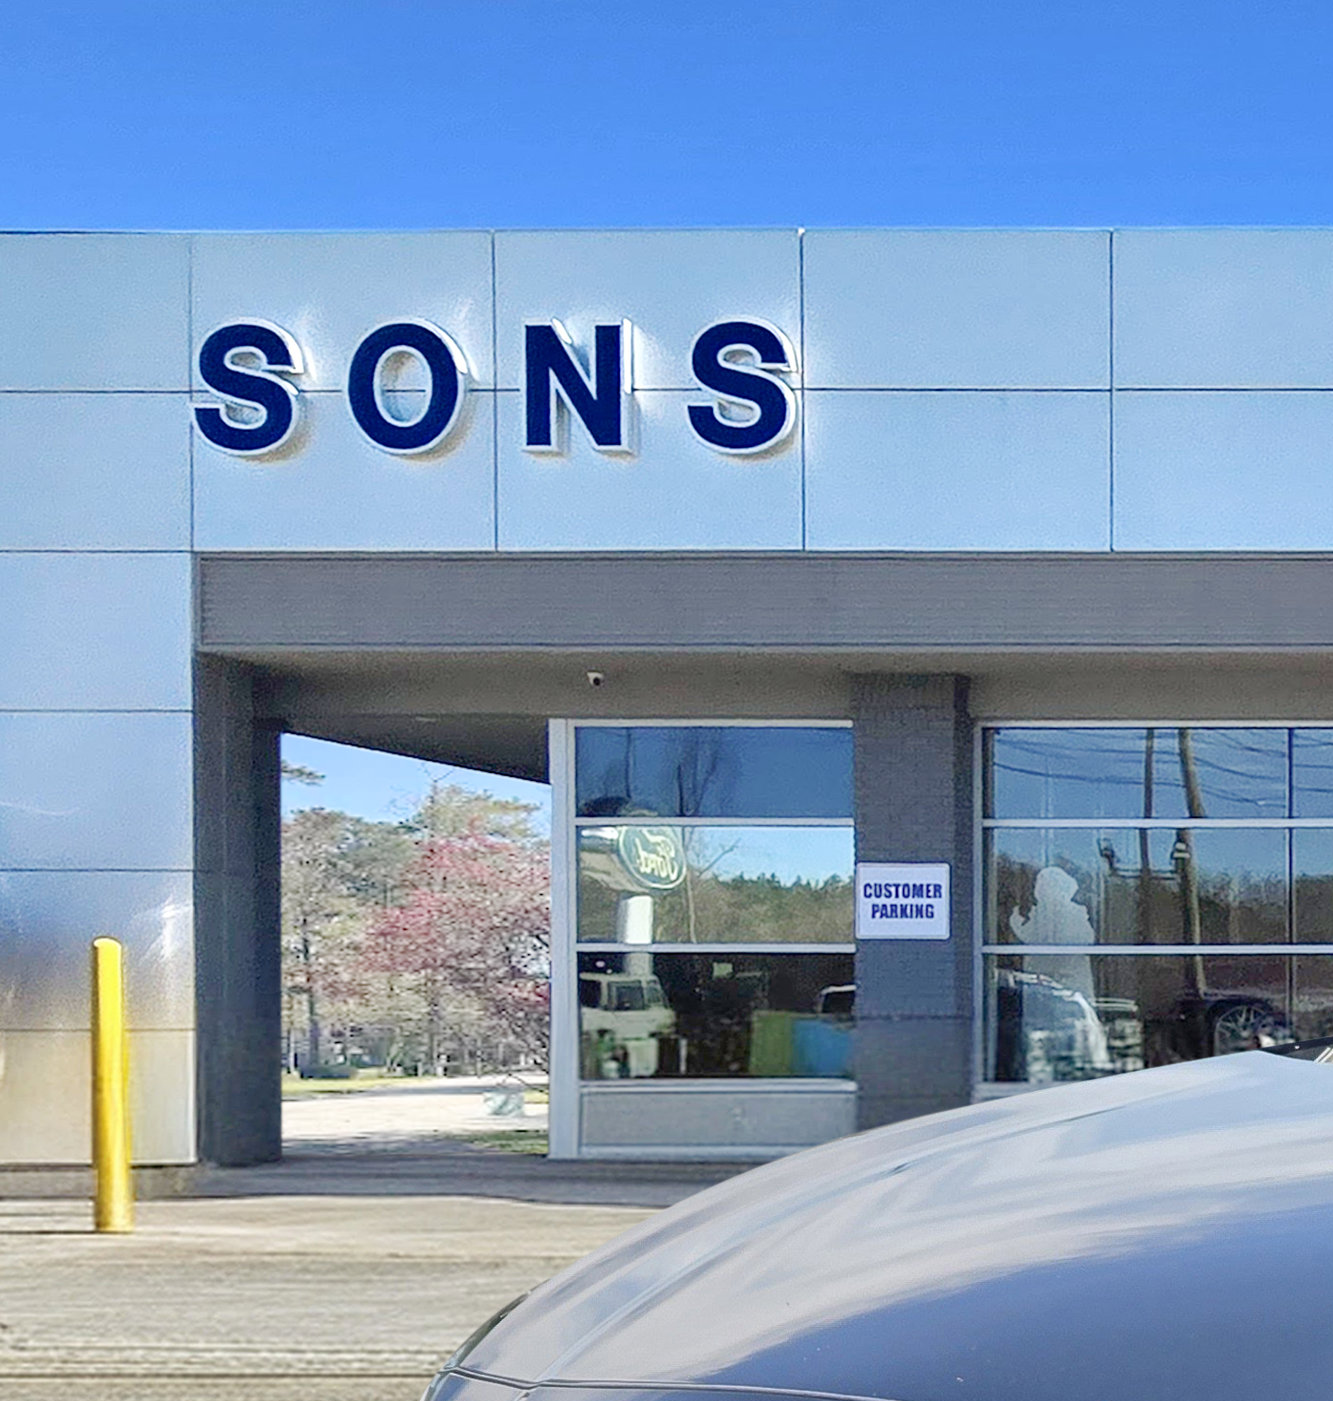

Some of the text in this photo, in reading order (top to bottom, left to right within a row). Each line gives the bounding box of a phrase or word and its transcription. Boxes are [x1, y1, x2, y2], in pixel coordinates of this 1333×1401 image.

[193, 319, 797, 456] SONS
[863, 882, 943, 899] CUSTOMER
[871, 903, 935, 919] PARKING
